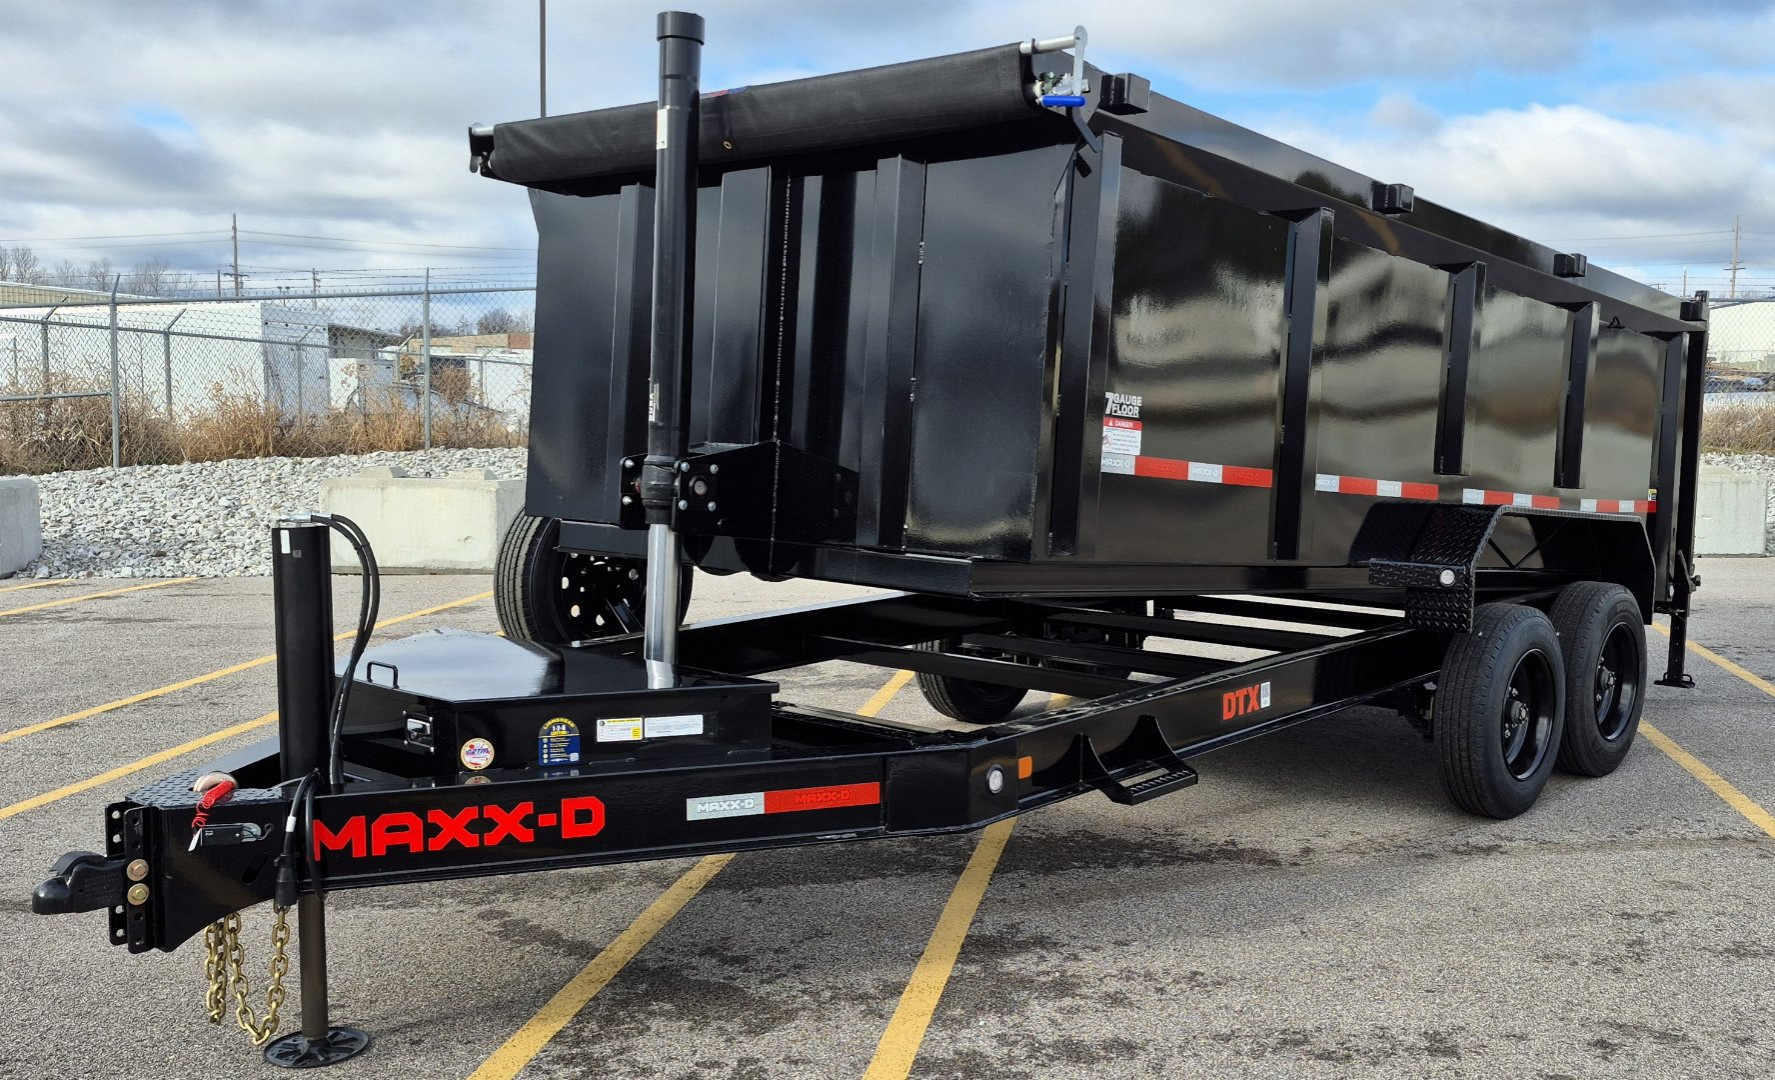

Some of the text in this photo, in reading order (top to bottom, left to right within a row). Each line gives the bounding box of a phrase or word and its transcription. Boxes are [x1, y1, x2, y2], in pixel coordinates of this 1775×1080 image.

[1104, 391, 1143, 415] 7 GAUGE
[1112, 403, 1140, 417] FLOOR
[1114, 420, 1134, 429] DANGER
[1222, 684, 1260, 720] DTX
[794, 790, 850, 804] MAXX-D
[697, 799, 755, 813] MAXX-D
[312, 796, 605, 861] MAXX-D
